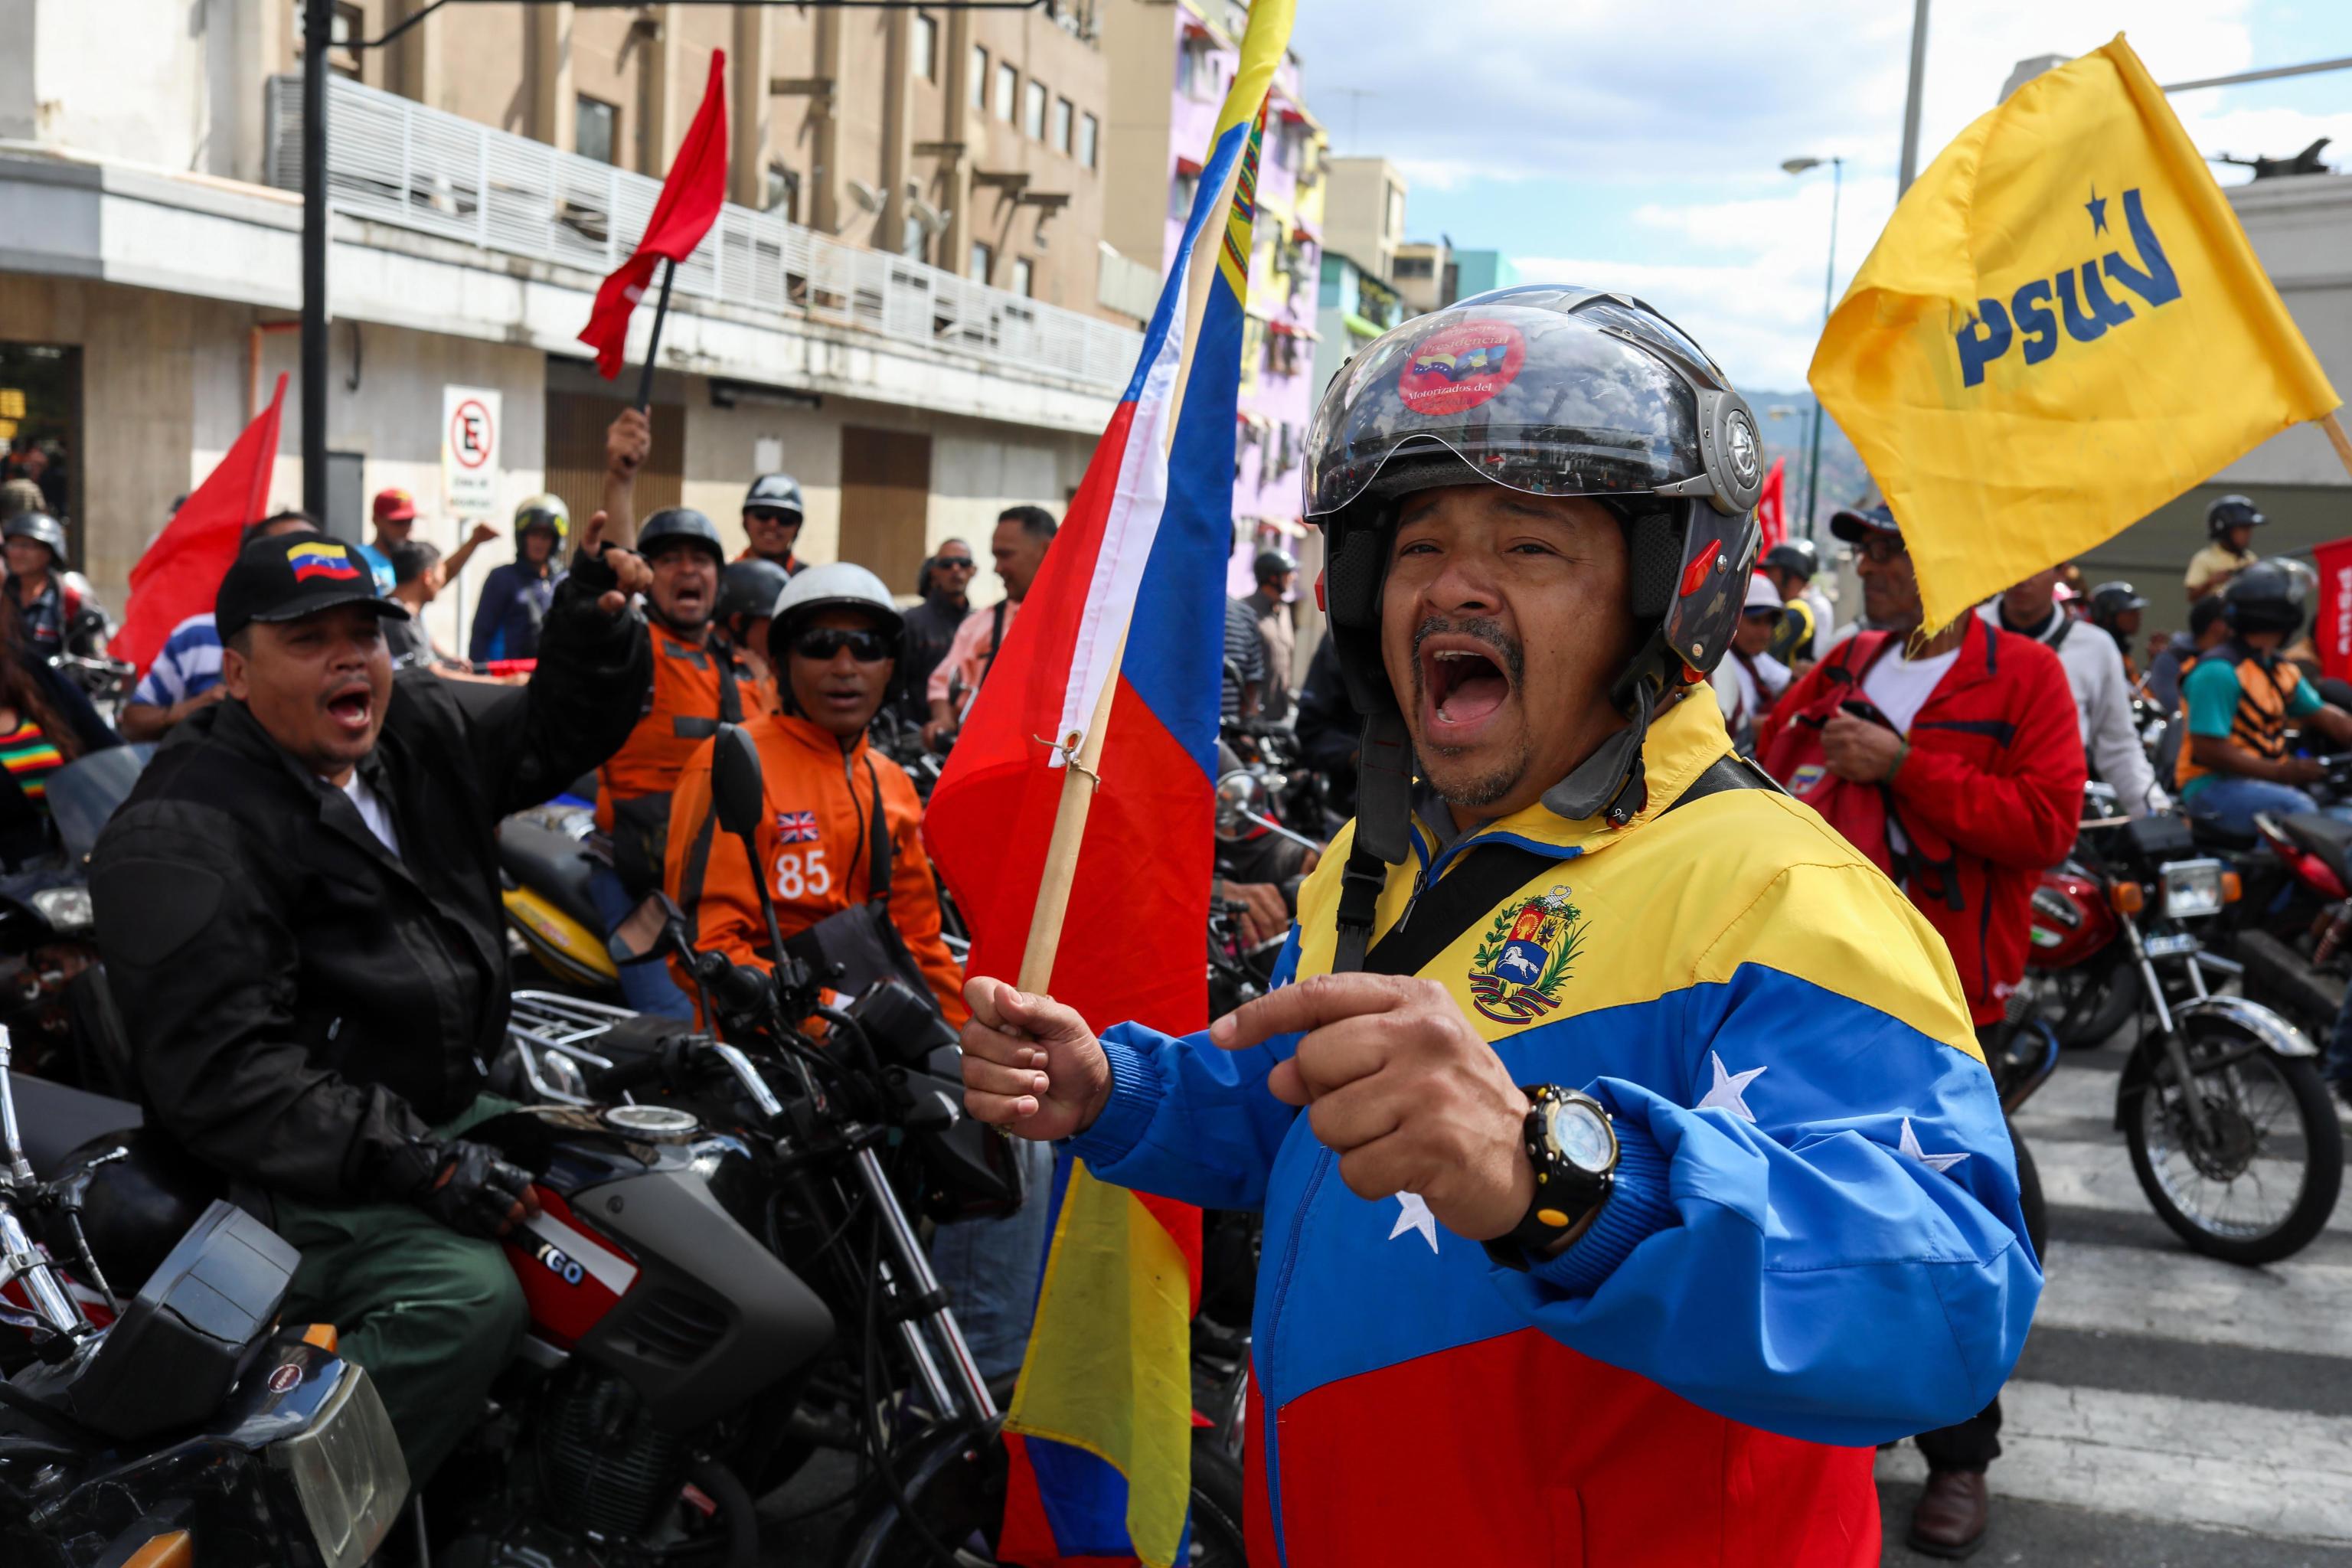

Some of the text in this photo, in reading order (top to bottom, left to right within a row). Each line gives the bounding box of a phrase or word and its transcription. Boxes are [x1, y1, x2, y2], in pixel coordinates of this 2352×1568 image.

[1423, 335, 1509, 354] Presidencial
[1408, 383, 1492, 400] Motorizados del
[463, 417, 480, 450] E
[776, 850, 830, 900] 85
